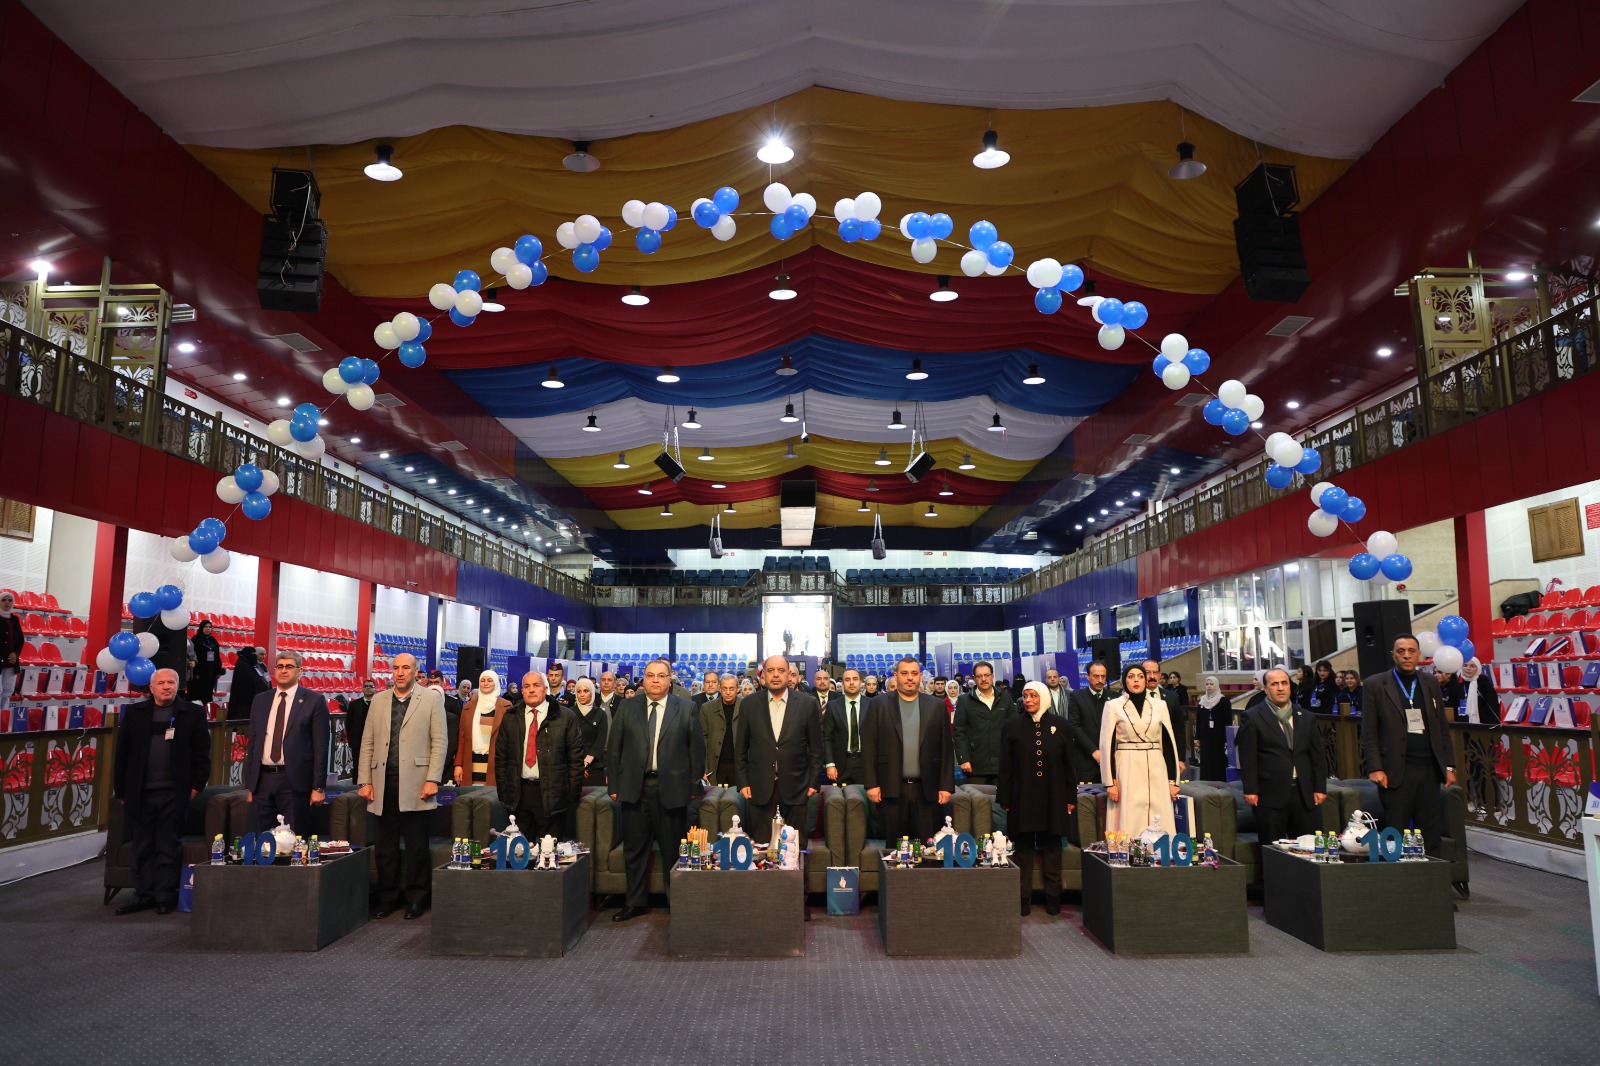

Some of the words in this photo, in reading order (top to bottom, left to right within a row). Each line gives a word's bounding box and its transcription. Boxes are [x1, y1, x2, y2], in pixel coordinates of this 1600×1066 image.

[240, 832, 276, 866] 10
[490, 836, 530, 870] 10
[713, 836, 753, 870] 10
[936, 832, 977, 868] 10
[1153, 833, 1193, 866] 10
[1361, 827, 1402, 862] 10
